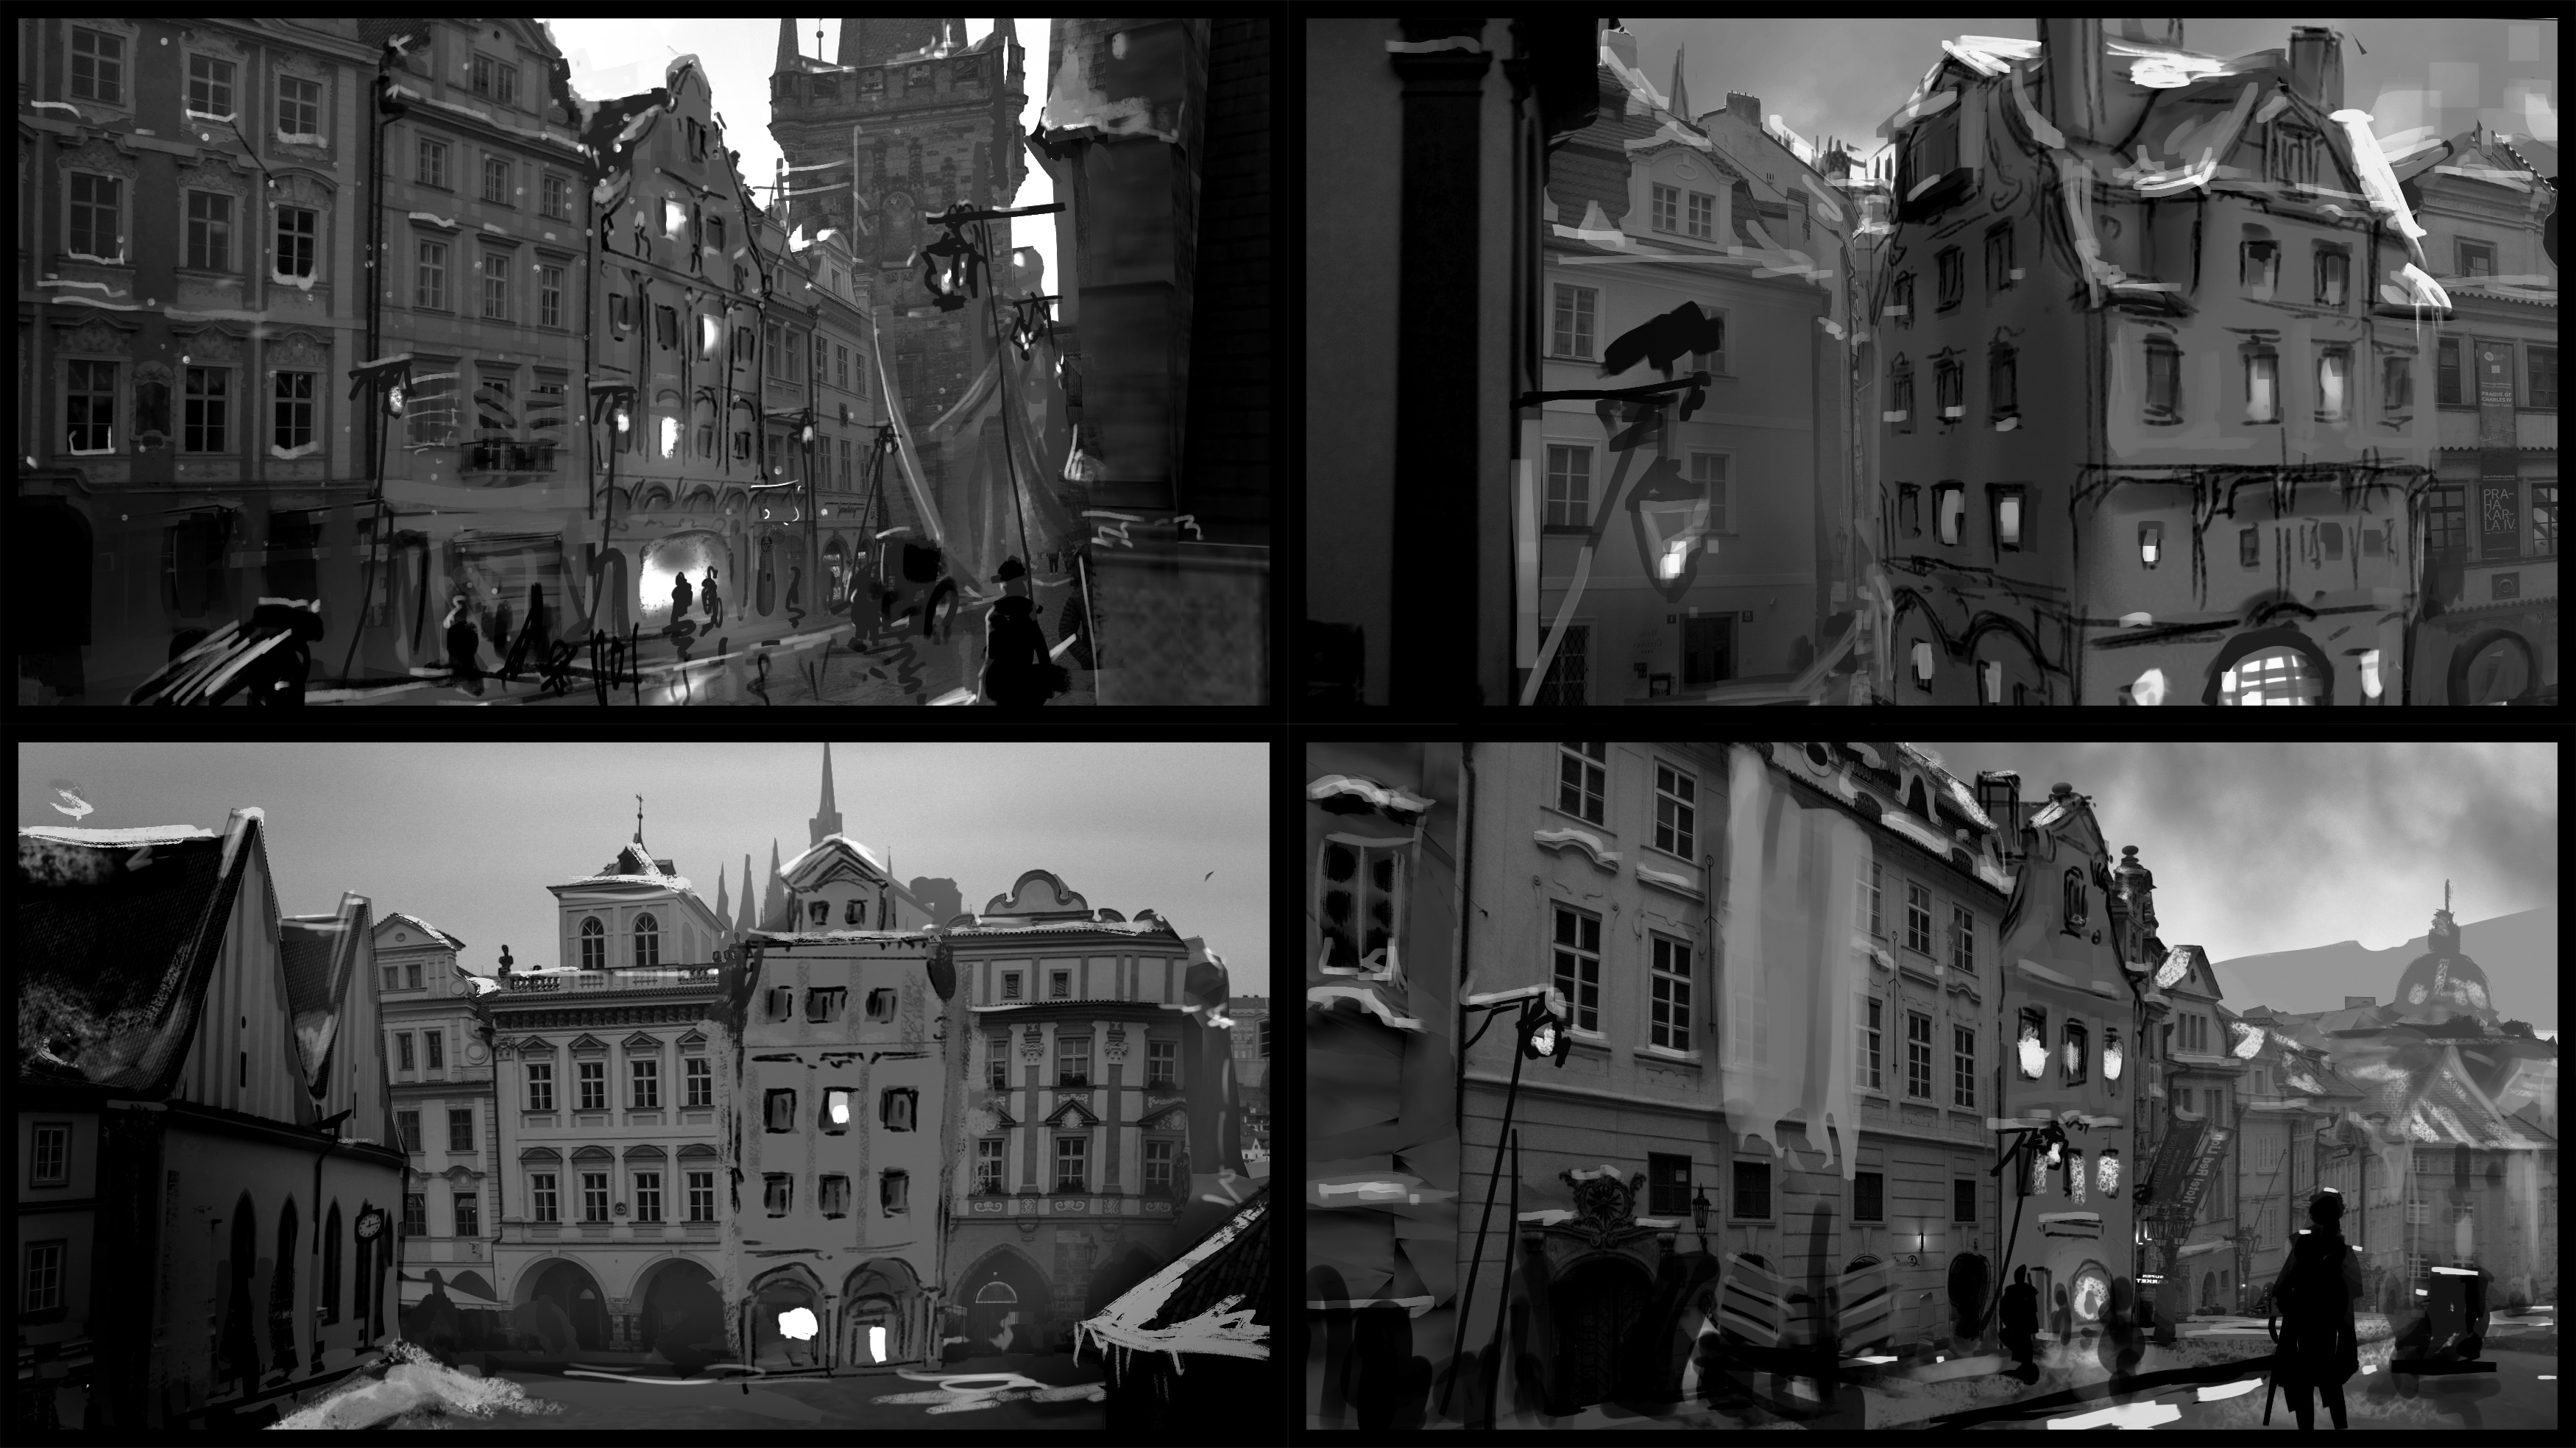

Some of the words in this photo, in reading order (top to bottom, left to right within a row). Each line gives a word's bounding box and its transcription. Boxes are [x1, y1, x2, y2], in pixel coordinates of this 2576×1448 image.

[2483, 488, 2514, 500] PRA-
[2484, 499, 2502, 510] HA
[2484, 509, 2515, 520] KAR-
[2484, 519, 2501, 531] LA
[2504, 519, 2516, 530] IV.
